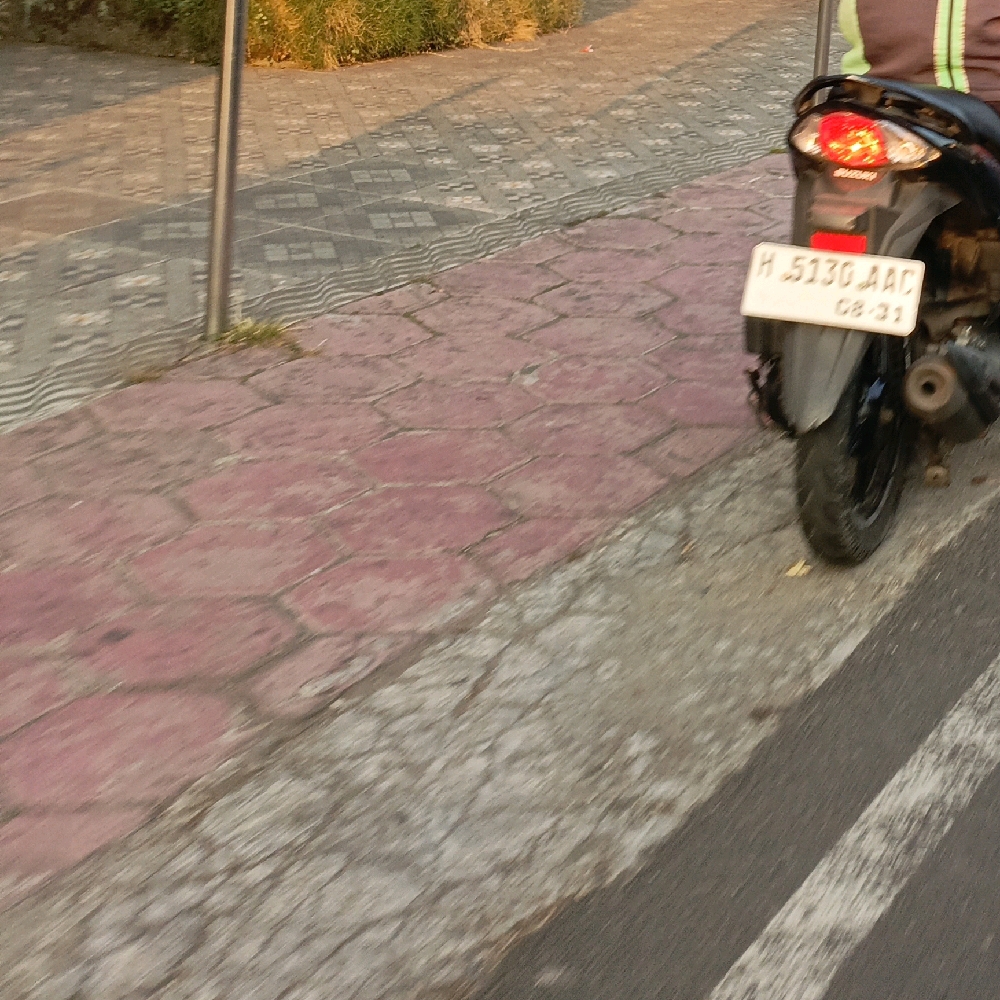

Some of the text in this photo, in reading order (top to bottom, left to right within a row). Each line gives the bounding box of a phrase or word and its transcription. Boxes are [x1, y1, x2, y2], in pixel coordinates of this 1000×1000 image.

[757, 251, 916, 296] H 5130 AAC
